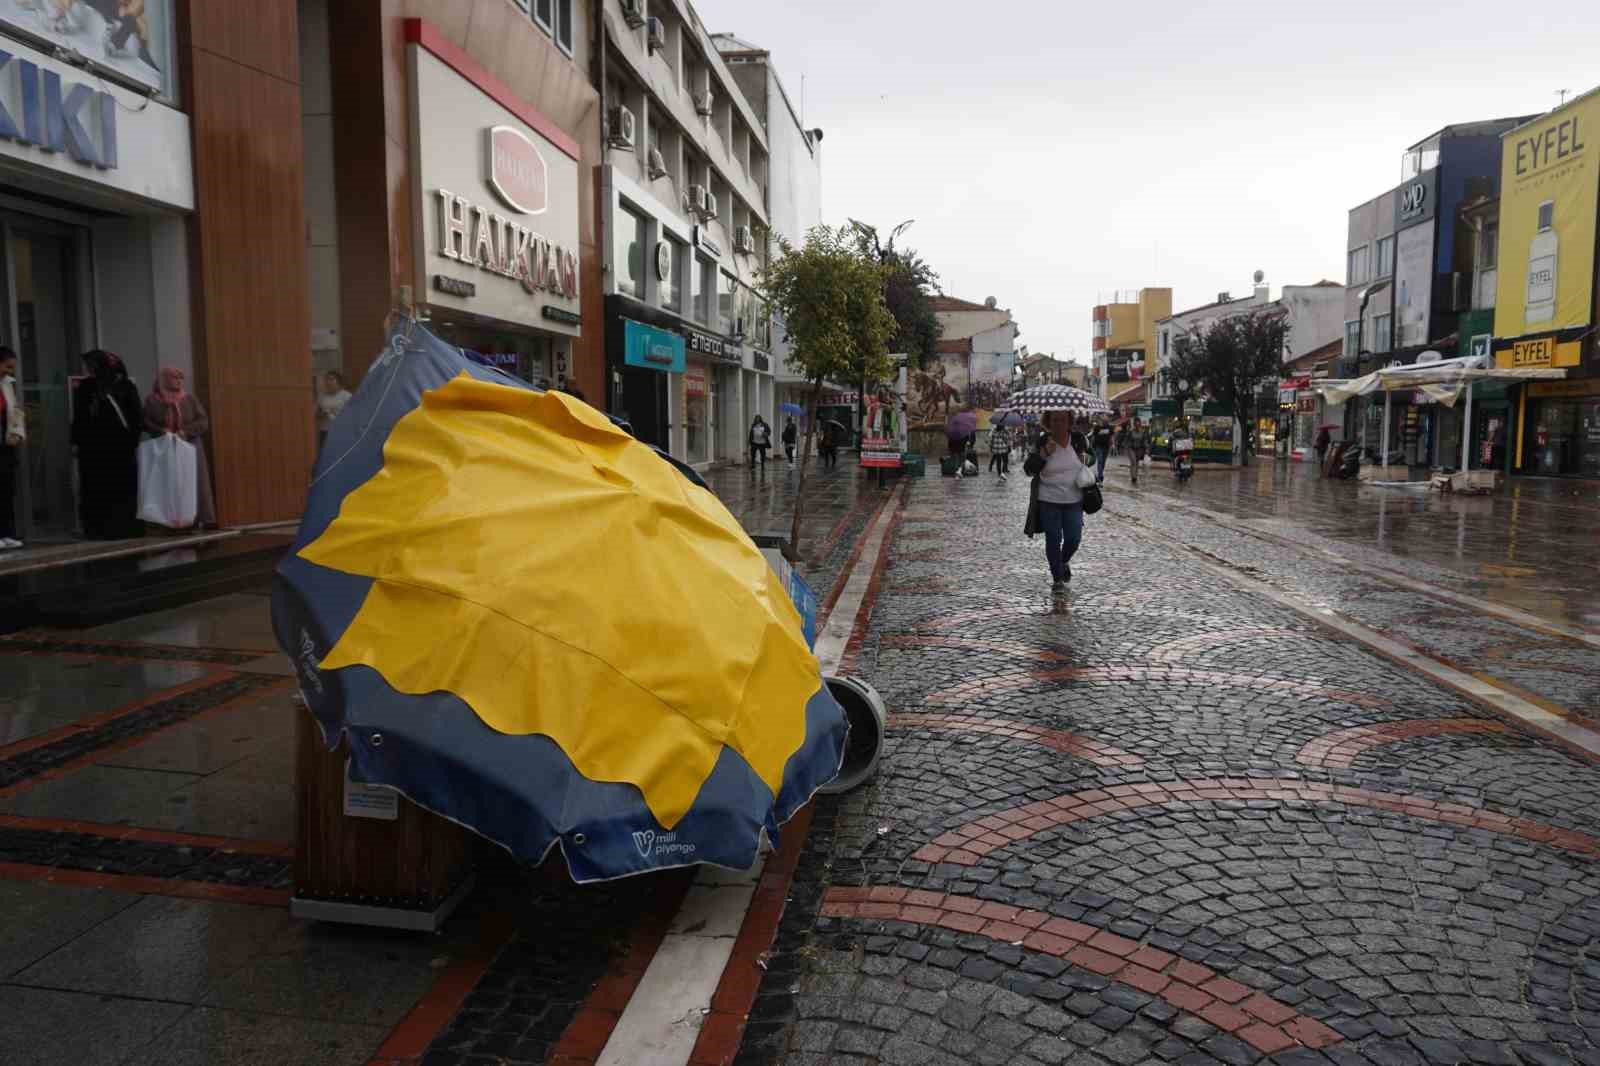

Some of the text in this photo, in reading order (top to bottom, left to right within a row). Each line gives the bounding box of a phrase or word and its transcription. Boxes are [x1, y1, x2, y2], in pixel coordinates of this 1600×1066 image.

[1516, 116, 1584, 176] EYFEL
[1514, 341, 1550, 362] EYFEL
[656, 843, 696, 855] piyango
